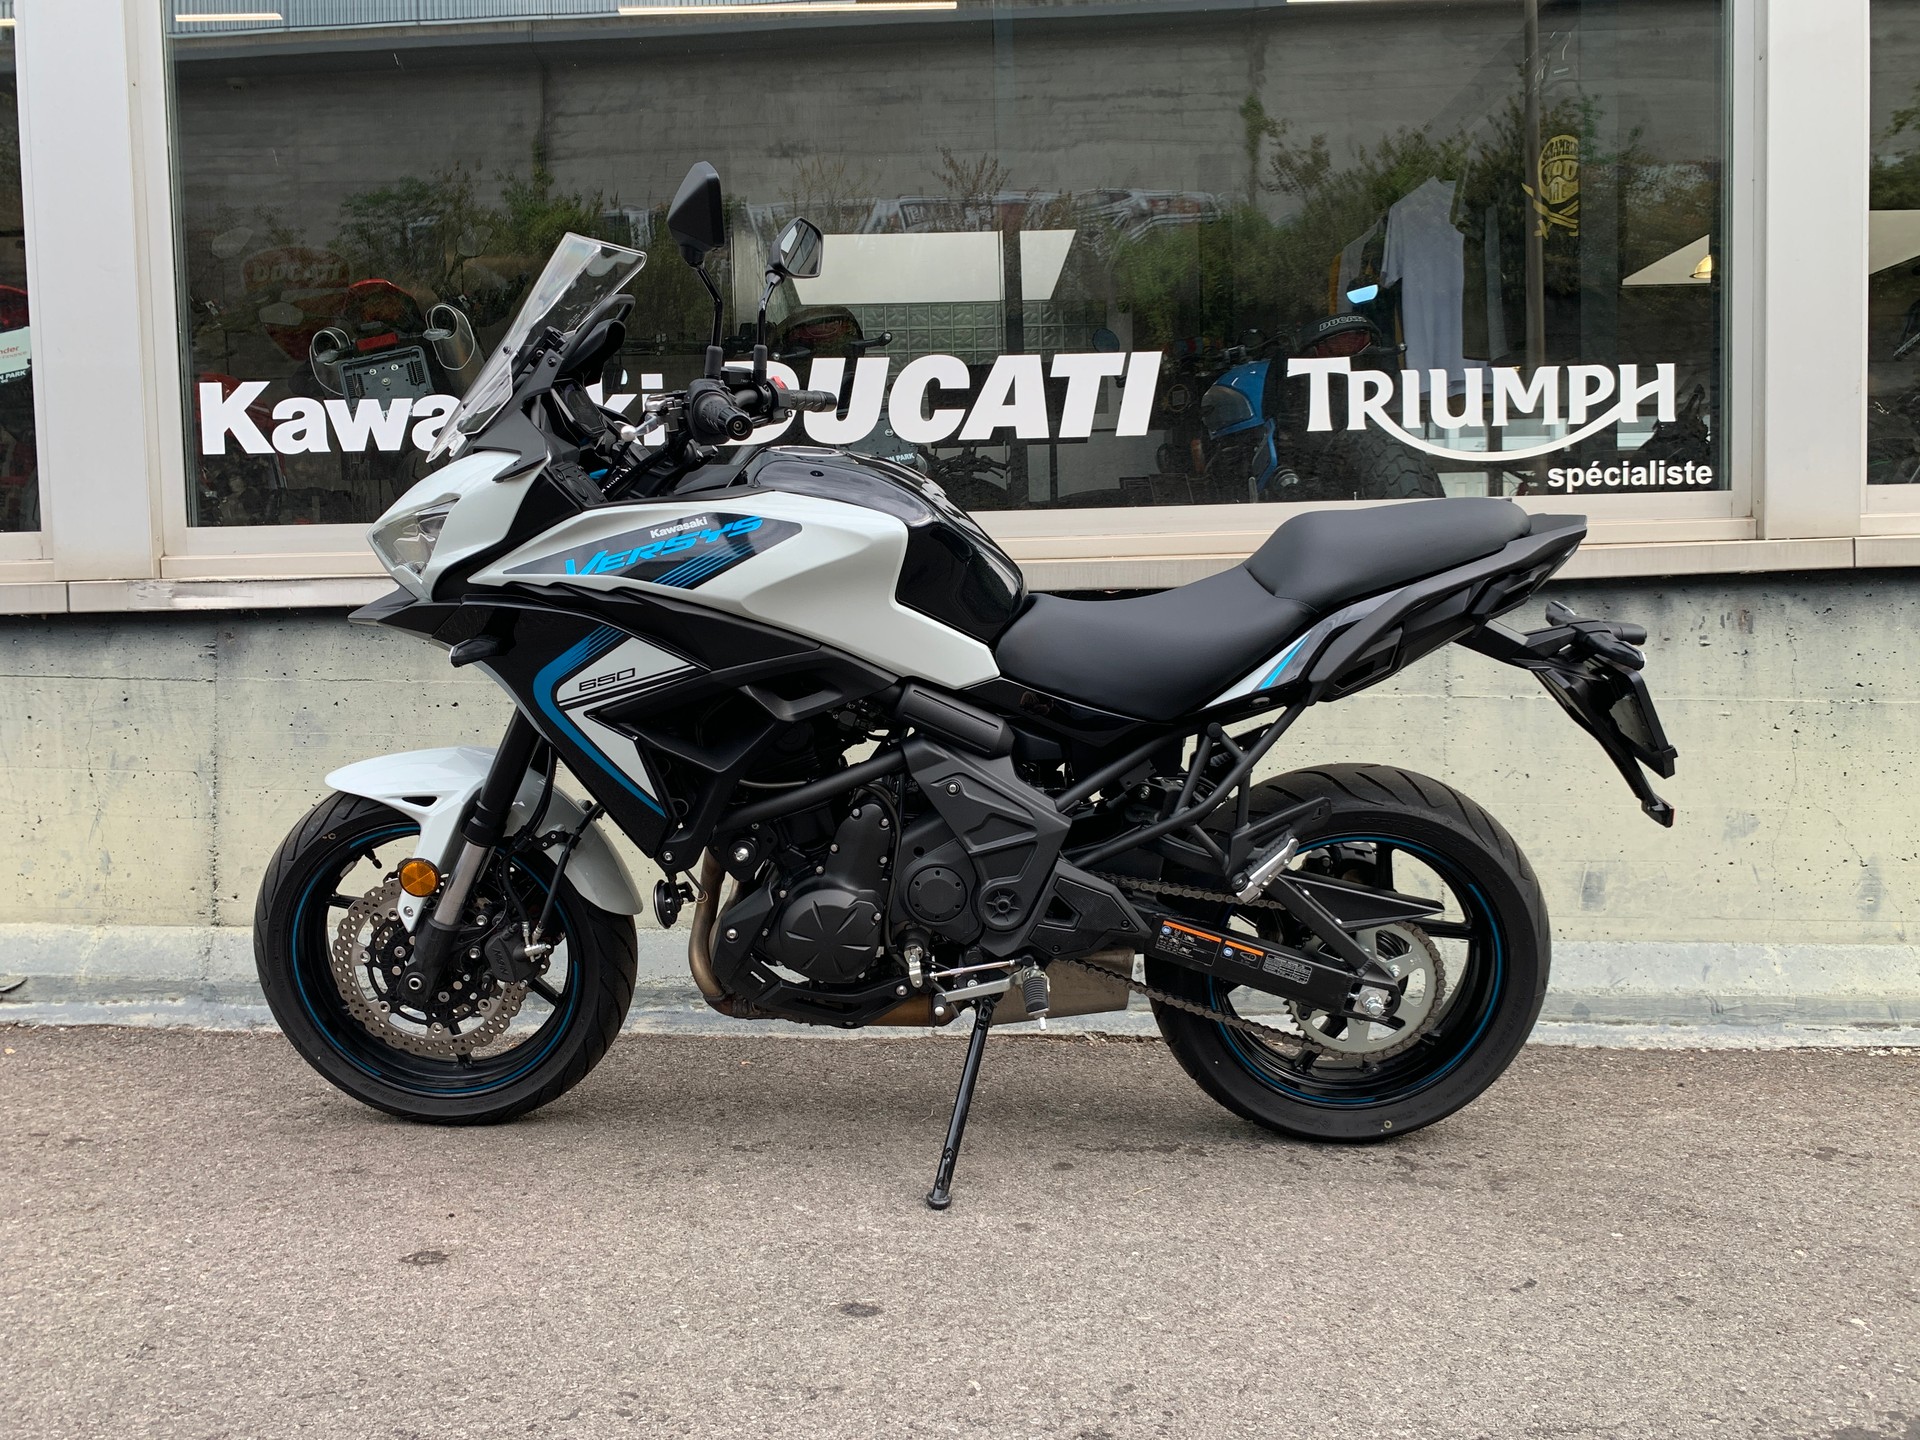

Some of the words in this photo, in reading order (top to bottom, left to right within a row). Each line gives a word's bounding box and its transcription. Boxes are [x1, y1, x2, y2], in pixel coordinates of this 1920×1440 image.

[199, 373, 666, 455] Kawaki
[1286, 356, 1676, 461] TRIUMPH
[895, 452, 915, 462] PARK
[1547, 460, 1713, 493] spécialiste
[650, 516, 709, 539] Kawasaki
[564, 515, 763, 576] VERSYS
[578, 667, 636, 692] 650
